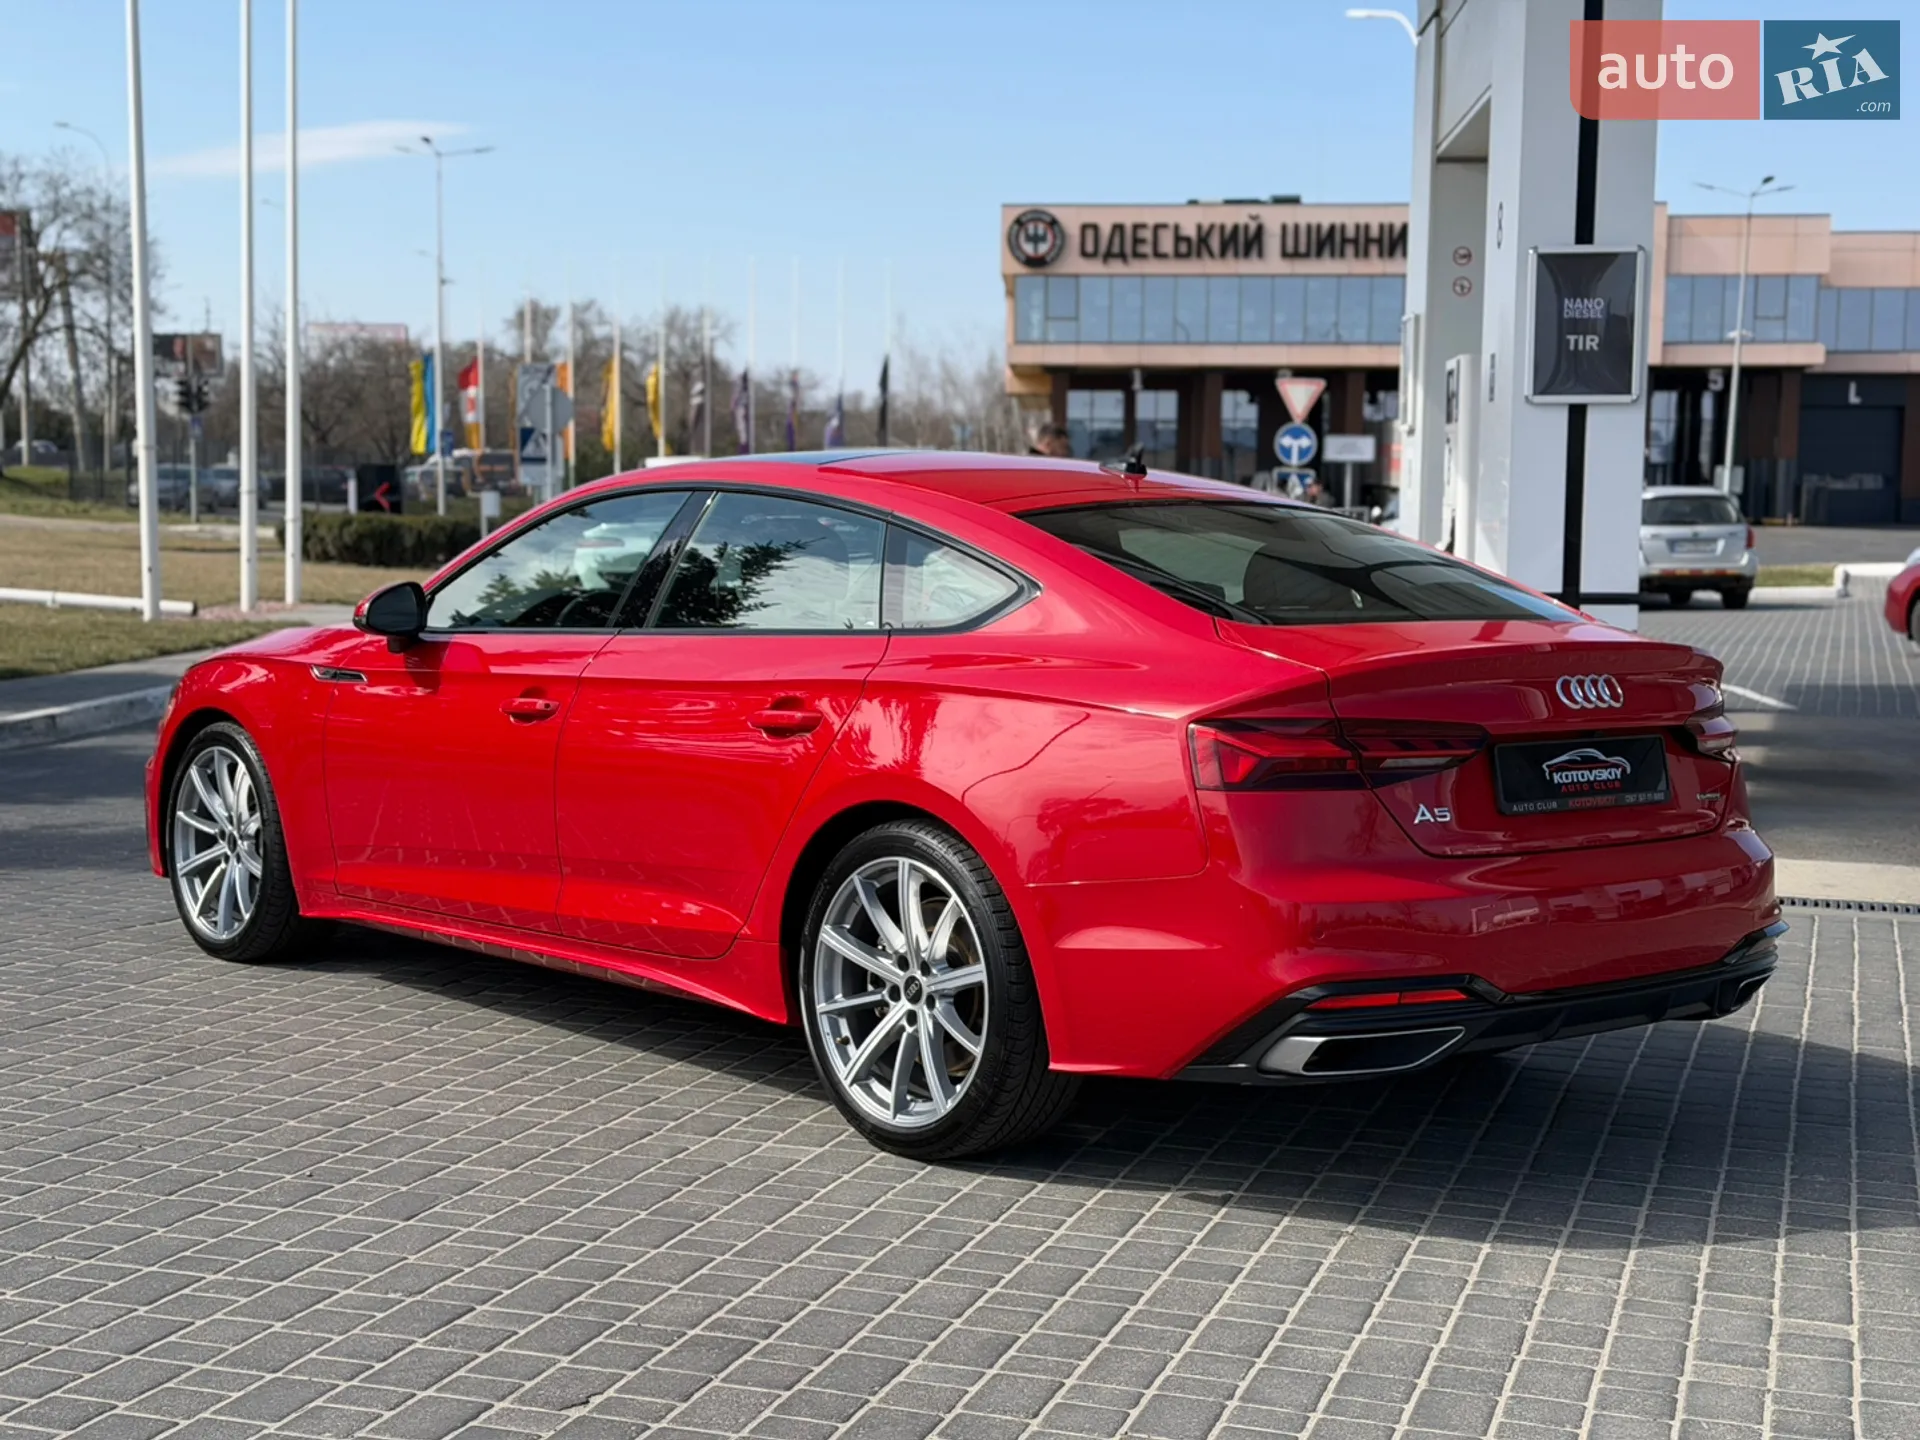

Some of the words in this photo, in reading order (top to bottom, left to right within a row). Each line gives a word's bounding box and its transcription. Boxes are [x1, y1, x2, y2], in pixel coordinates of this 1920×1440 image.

[1080, 214, 1264, 264] ОДЕСЬКИЙ
[1563, 297, 1604, 309] NANO
[1563, 308, 1603, 319] DIESEL
[1566, 334, 1600, 351] TIR
[1553, 767, 1623, 784] KOTOVSKIY
[1561, 783, 1589, 793] AUTO
[1593, 781, 1621, 790] CLUB
[1512, 803, 1535, 812] AUTO
[1536, 801, 1558, 811] CLUB
[1413, 803, 1452, 825] A5
